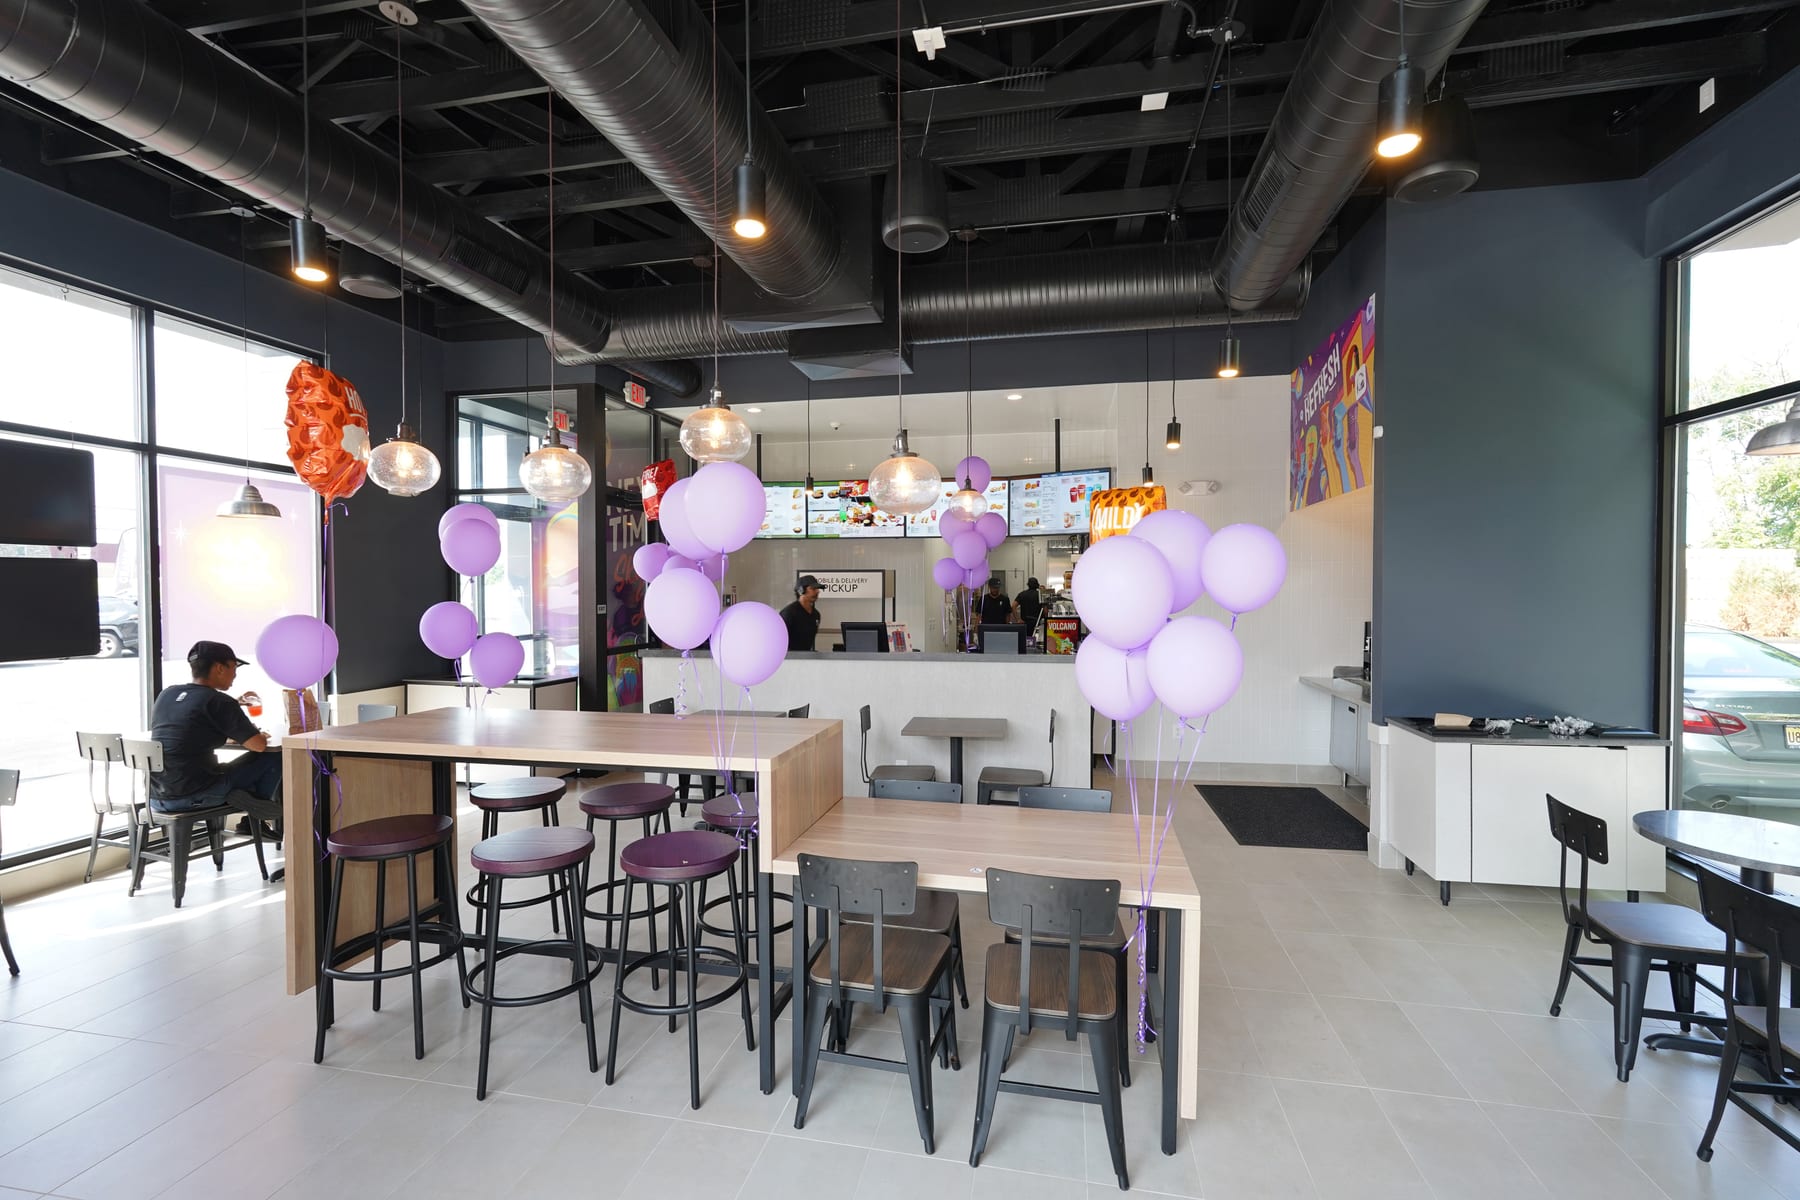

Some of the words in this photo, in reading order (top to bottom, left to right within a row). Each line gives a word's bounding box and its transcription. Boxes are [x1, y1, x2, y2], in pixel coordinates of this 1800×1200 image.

[1303, 341, 1341, 425] REFRESH
[344, 386, 365, 415] HO
[631, 383, 645, 405] EXIT
[642, 466, 659, 481] FIRE!
[823, 584, 858, 592] PICKUP
[1048, 622, 1077, 630] VOLCANO
